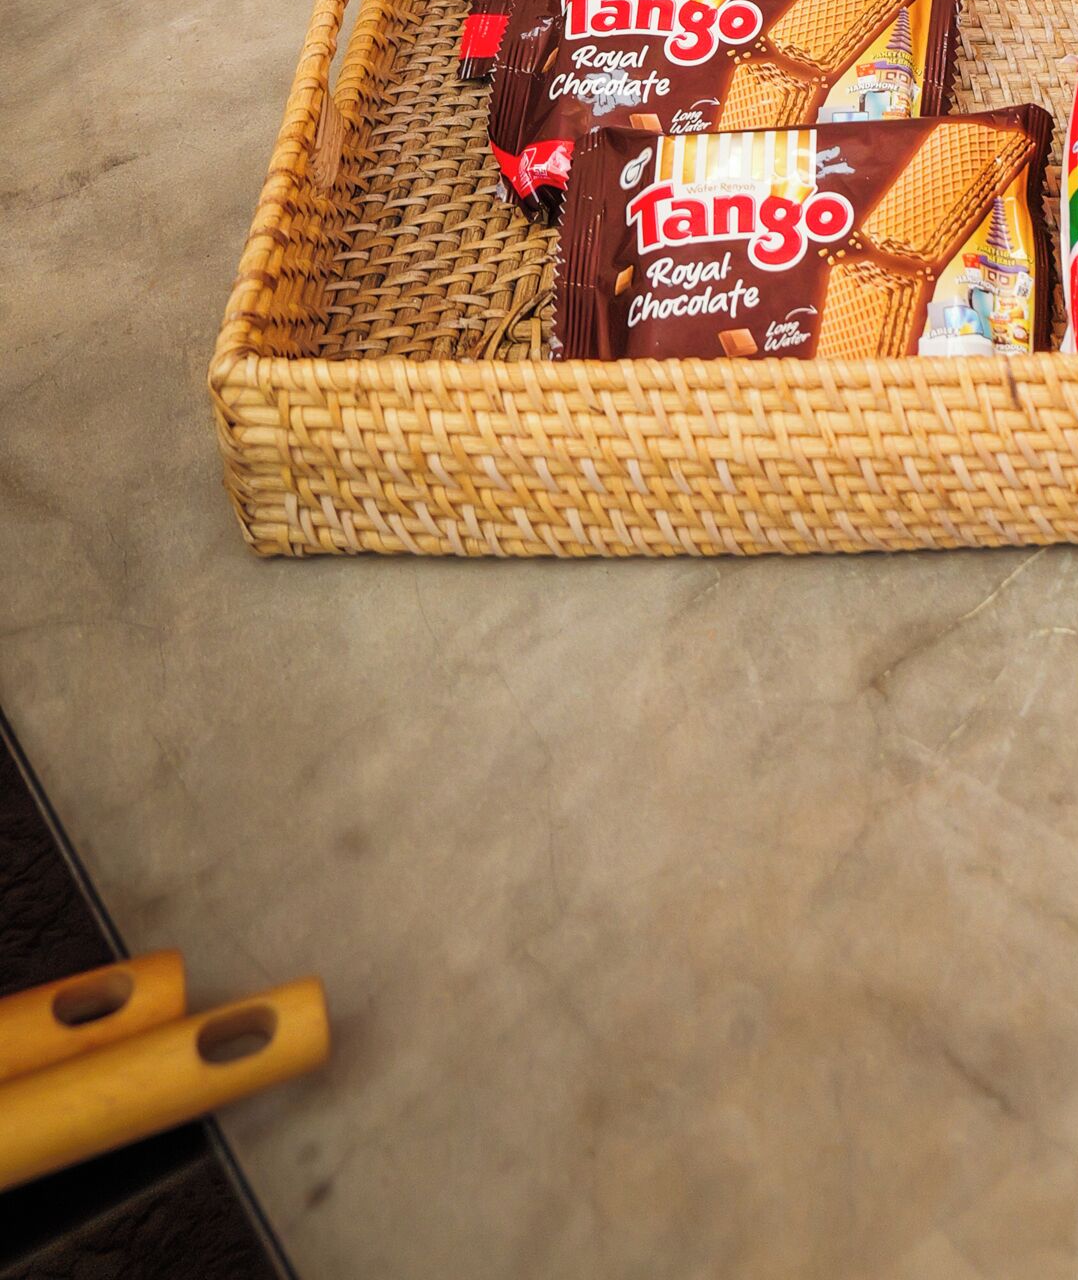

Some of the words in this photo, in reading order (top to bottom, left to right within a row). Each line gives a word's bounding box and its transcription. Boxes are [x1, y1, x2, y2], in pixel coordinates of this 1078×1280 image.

[571, 45, 650, 72] Royal
[548, 70, 671, 103] Chocolate
[669, 120, 712, 135] Wafer
[671, 109, 703, 124] Long
[686, 183, 718, 195] Wafer
[720, 182, 756, 193] Renyah
[628, 183, 851, 269] Tango
[646, 251, 732, 290] Royal
[627, 279, 761, 328] Chocolate
[764, 321, 800, 338] Long
[763, 332, 811, 352] Wafer
